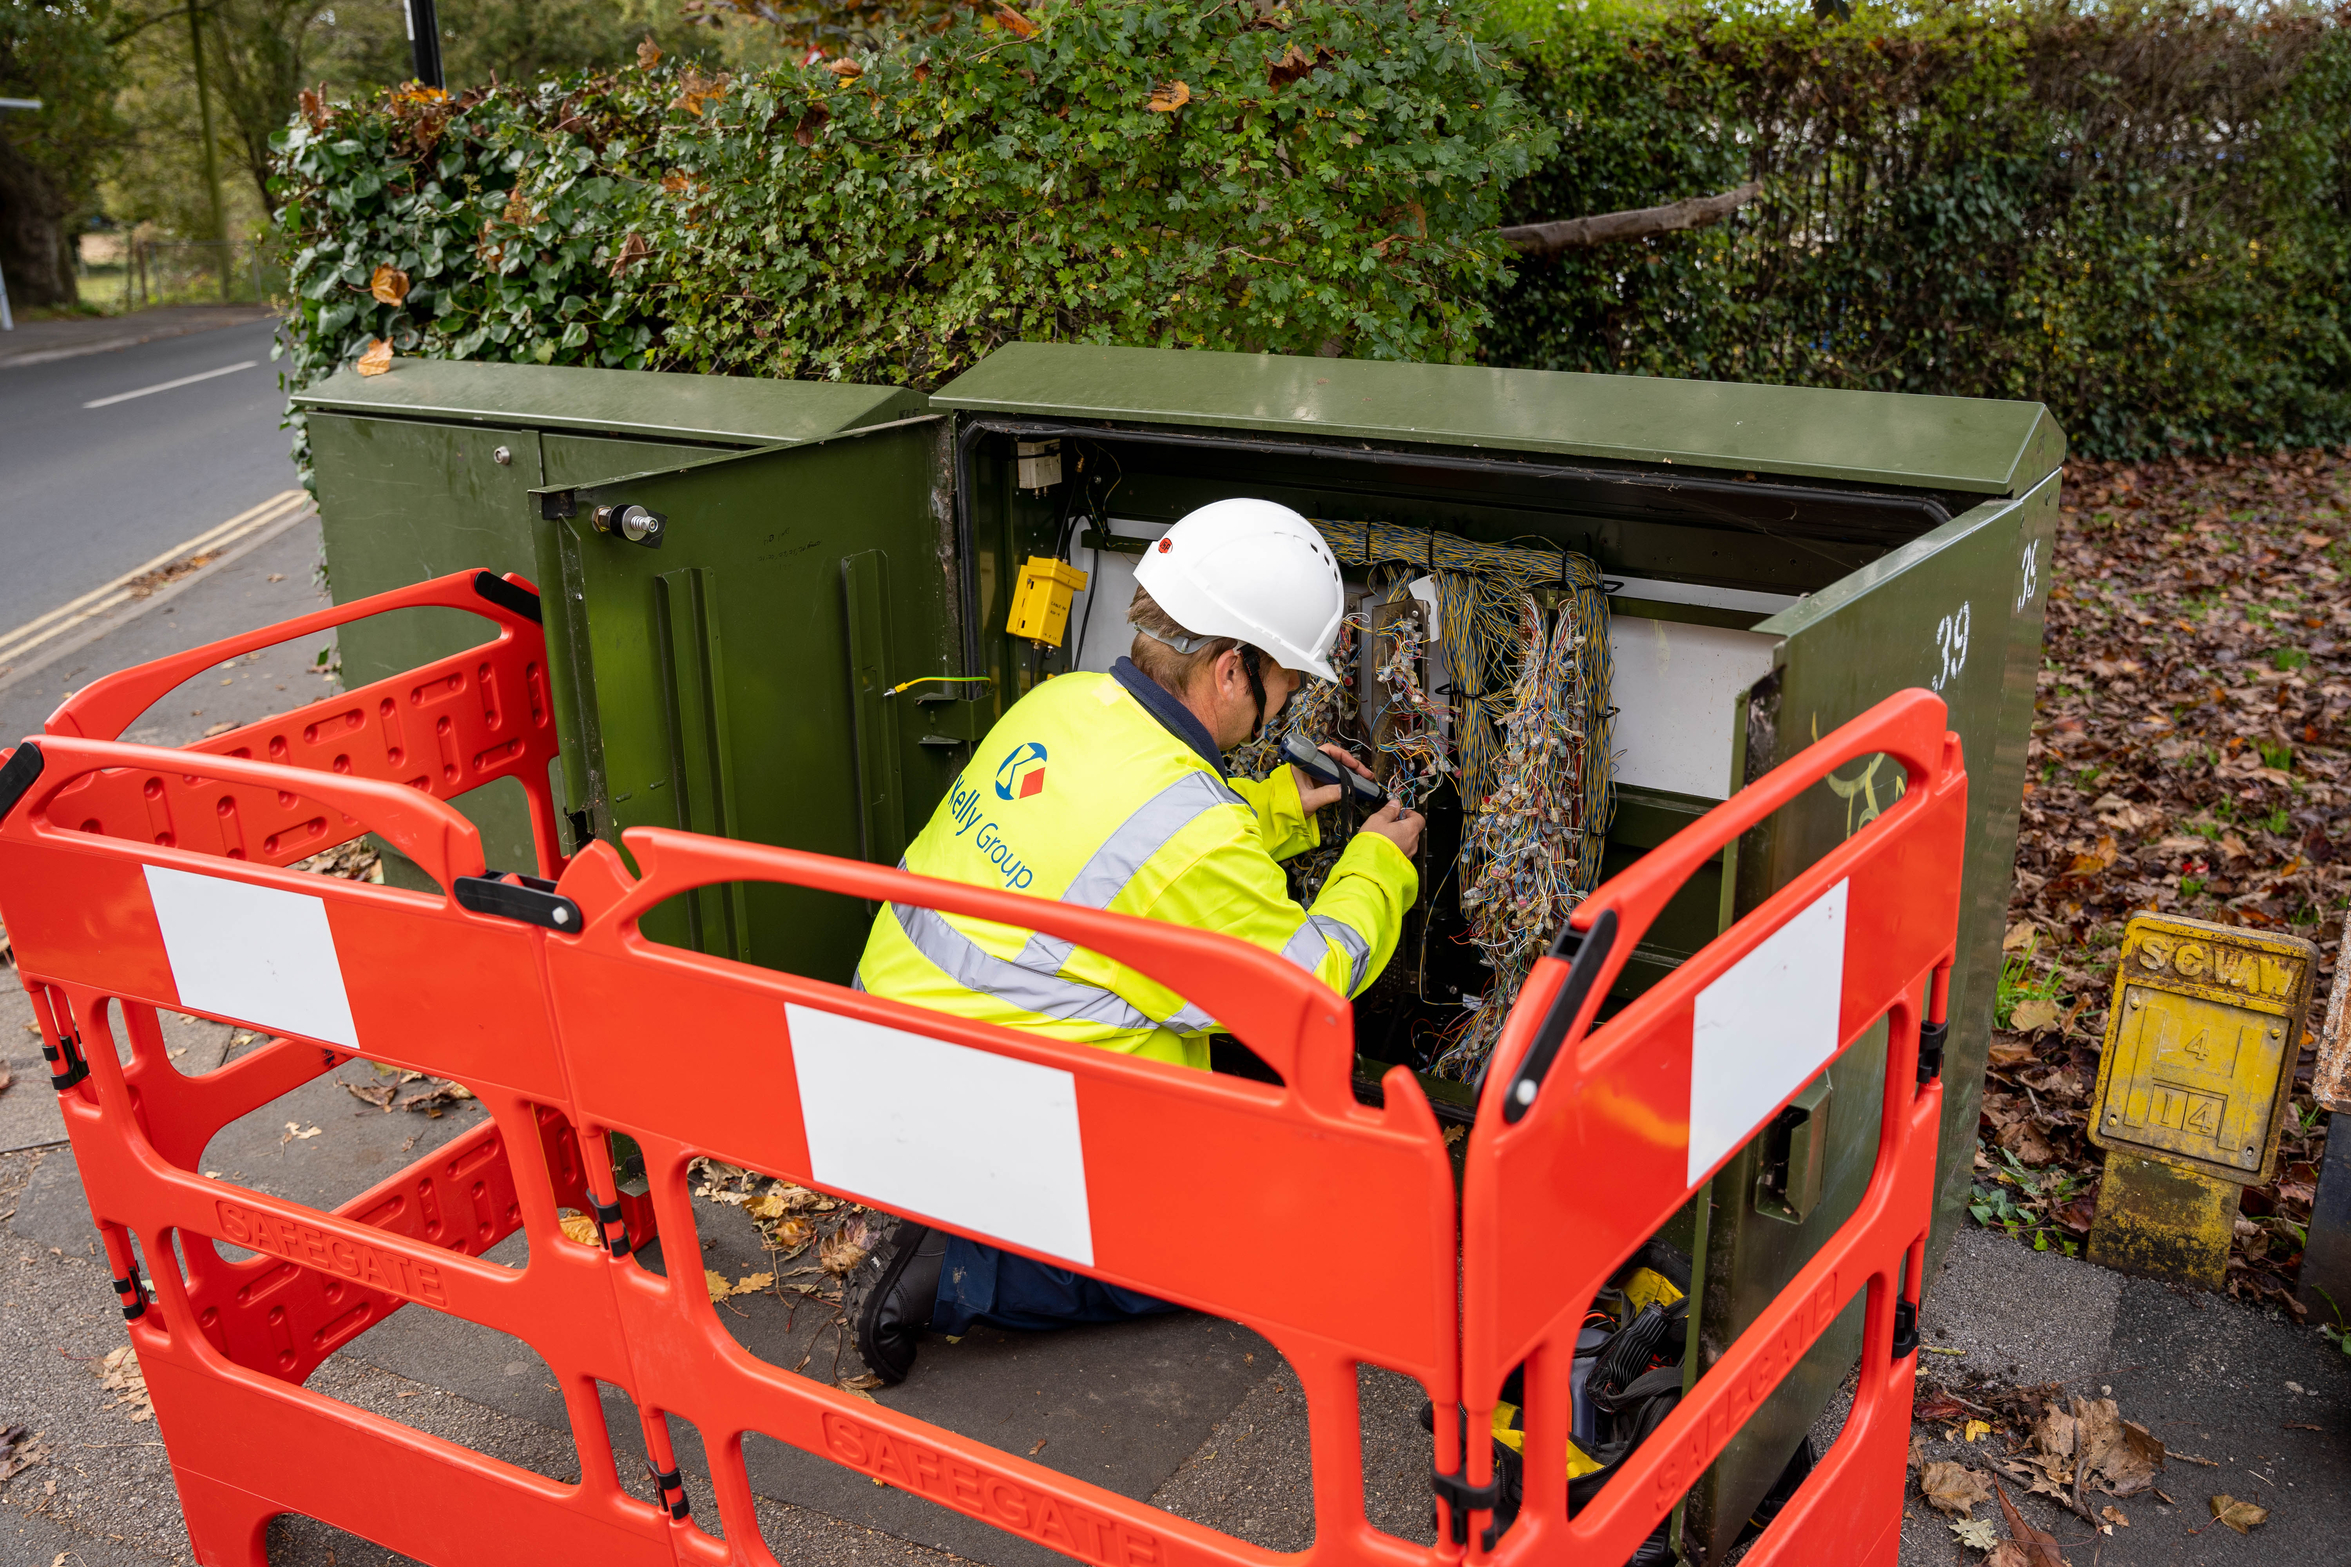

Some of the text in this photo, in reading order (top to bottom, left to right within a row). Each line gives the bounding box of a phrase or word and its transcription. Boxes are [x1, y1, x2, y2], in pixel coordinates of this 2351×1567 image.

[1931, 600, 1970, 694] 39
[947, 774, 1033, 889] Kelly Group
[2138, 936, 2300, 997] SCWW
[2184, 1028, 2209, 1060] 4
[220, 1202, 447, 1308] SAFEGATE
[829, 1415, 1158, 1567] SAFEGATE
